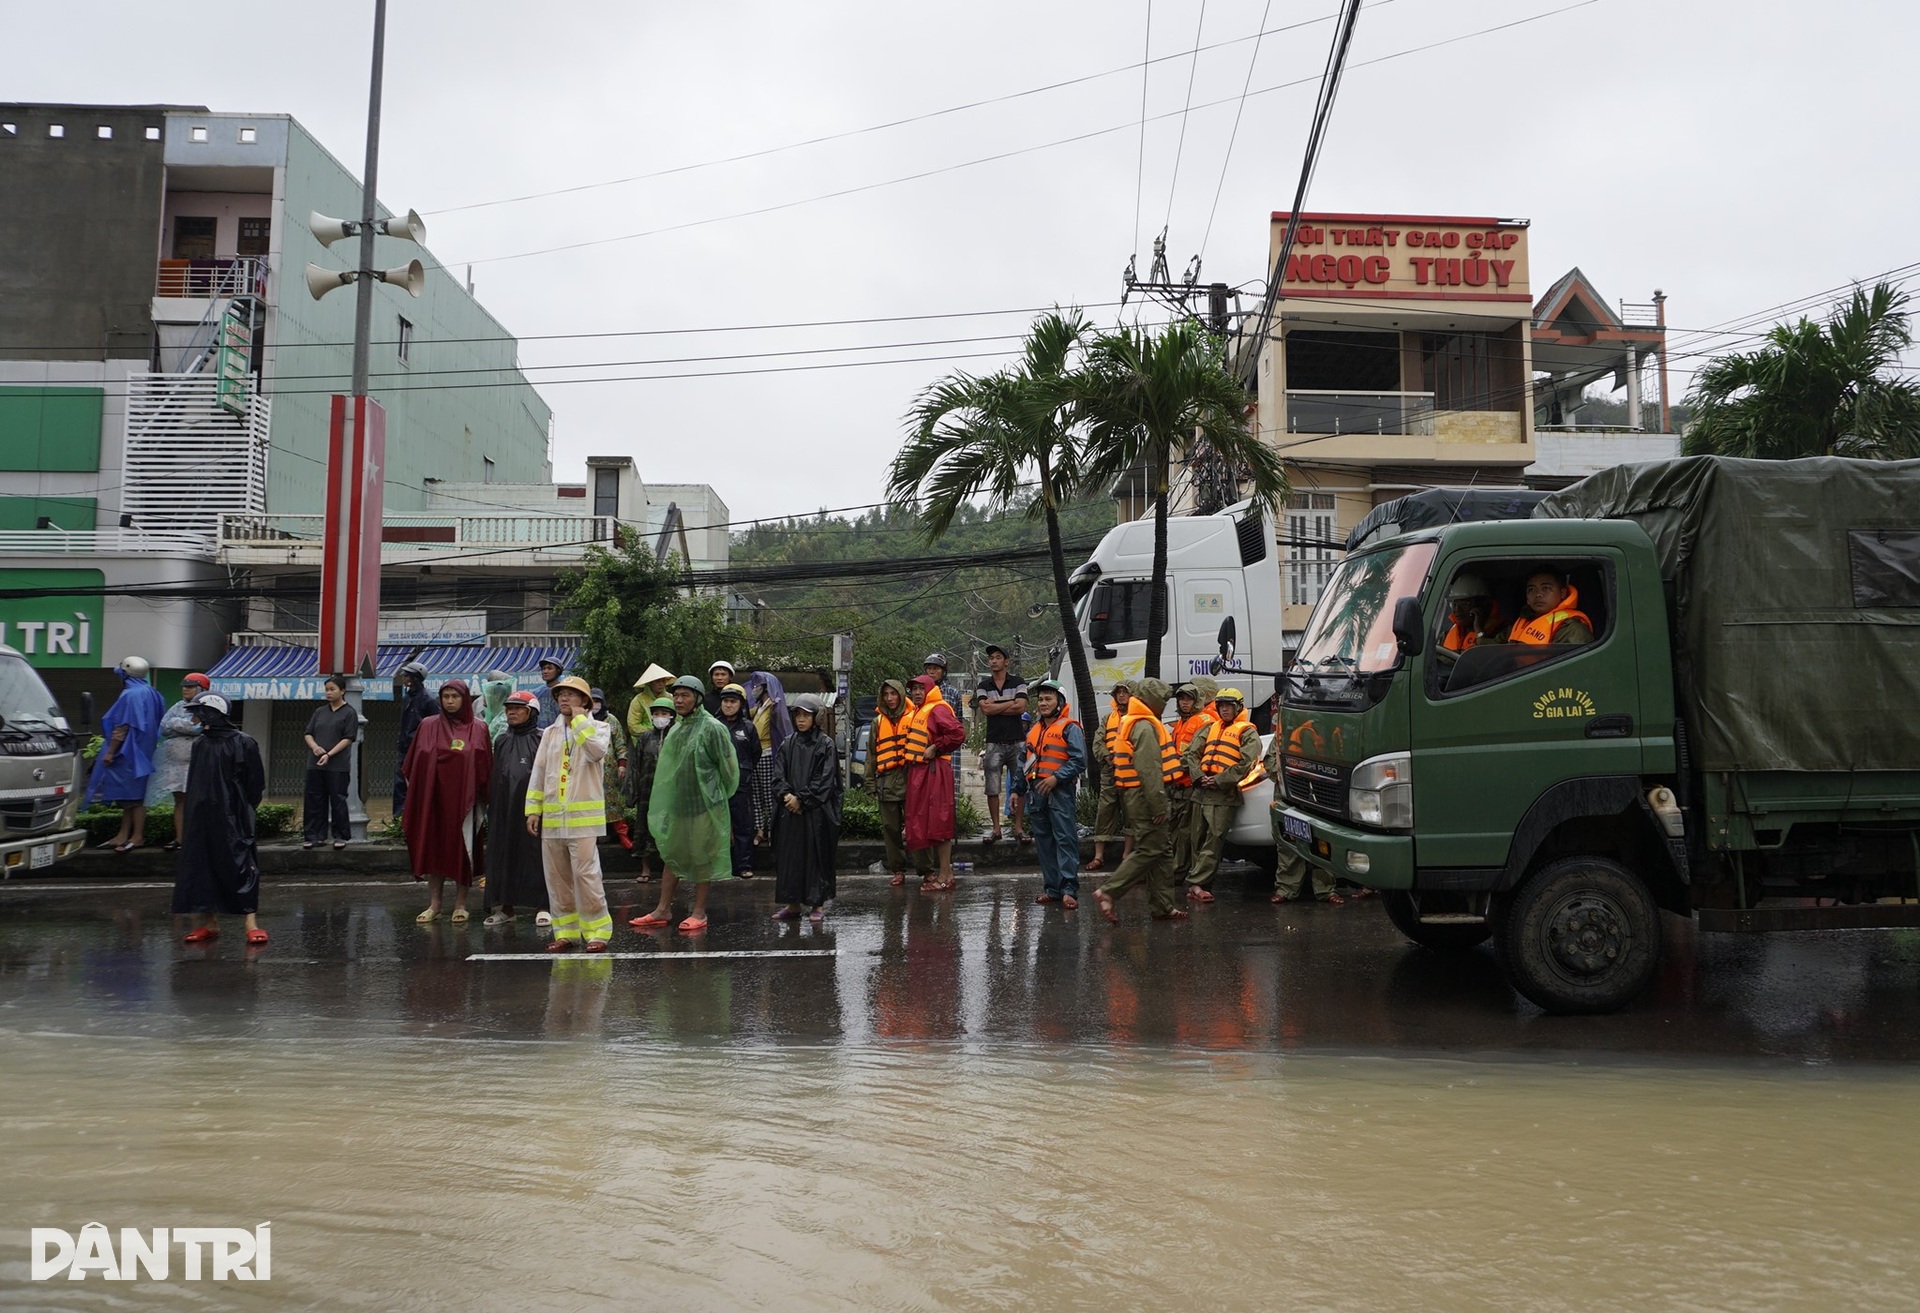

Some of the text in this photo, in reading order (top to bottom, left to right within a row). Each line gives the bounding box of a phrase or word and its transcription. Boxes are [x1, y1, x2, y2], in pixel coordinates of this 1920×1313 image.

[1330, 225, 1401, 246] THẤT
[1406, 230, 1461, 248] CAO
[1465, 228, 1520, 250] CẤP
[1286, 250, 1517, 289] NGỌC THỦY
[16, 612, 90, 654] TRÌ
[1467, 637, 1477, 645] CA
[1525, 627, 1546, 641] CAND
[243, 678, 292, 700] NHÂN
[294, 678, 314, 700] ÁI
[1339, 691, 1364, 700] CANTER
[1533, 688, 1596, 718] CÔNG AN TỈNH
[1546, 706, 1582, 718] GIA LAI
[1317, 764, 1338, 776] FUSO
